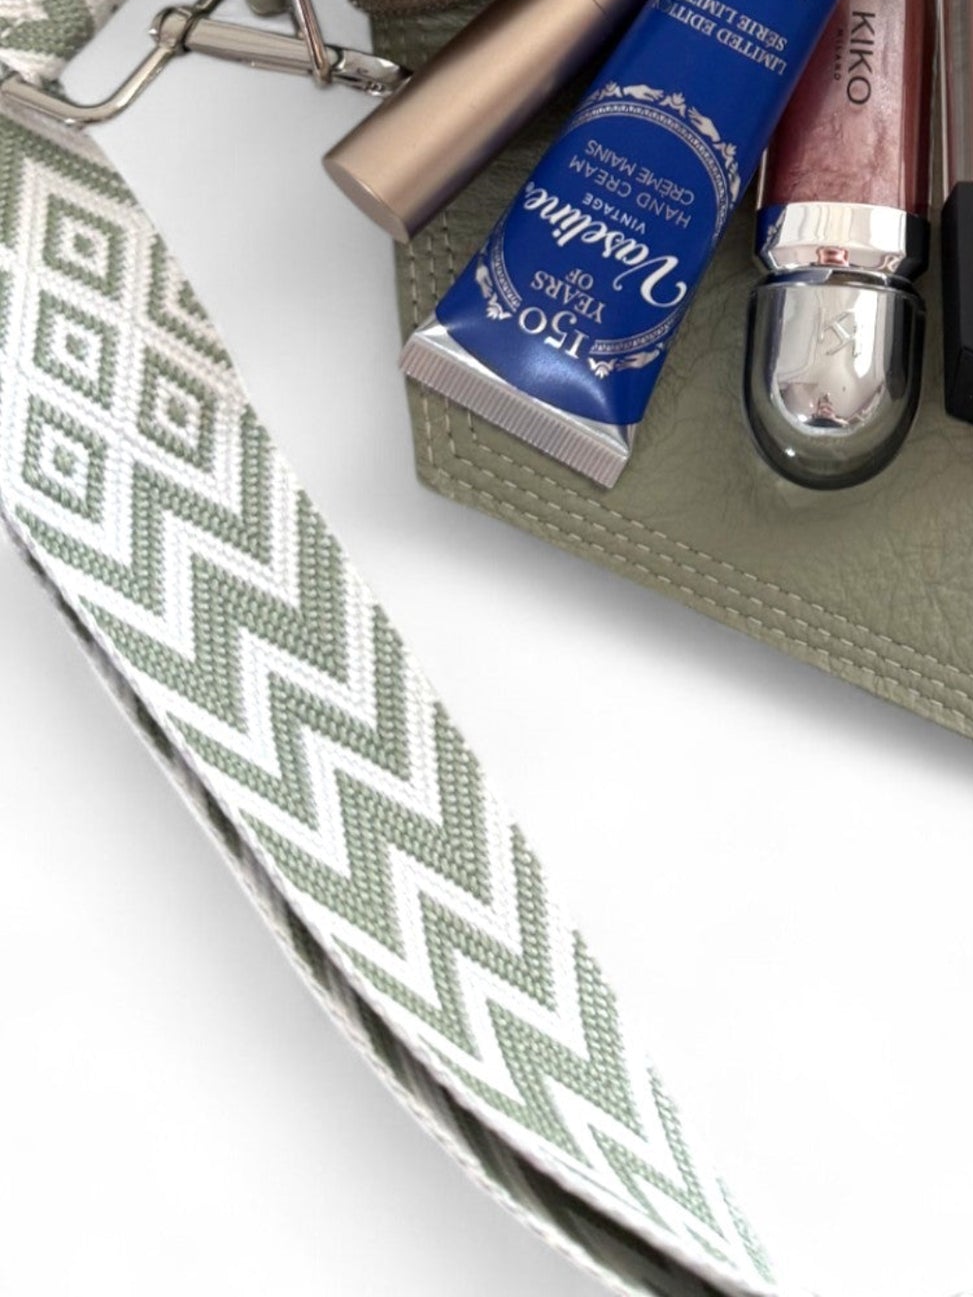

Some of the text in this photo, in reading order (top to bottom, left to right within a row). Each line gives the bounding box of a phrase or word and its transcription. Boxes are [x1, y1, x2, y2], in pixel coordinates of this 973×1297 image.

[716, 27, 789, 77] LIMITED
[737, 14, 788, 52] SÉRIE
[847, 10, 876, 105] KIKO
[569, 155, 692, 229] HAND CREAM
[584, 140, 696, 207] CRÈME MAINS
[582, 193, 647, 235] VINTAGE
[530, 270, 606, 324] YEARS
[565, 268, 594, 290] OF
[518, 305, 590, 360] 150
